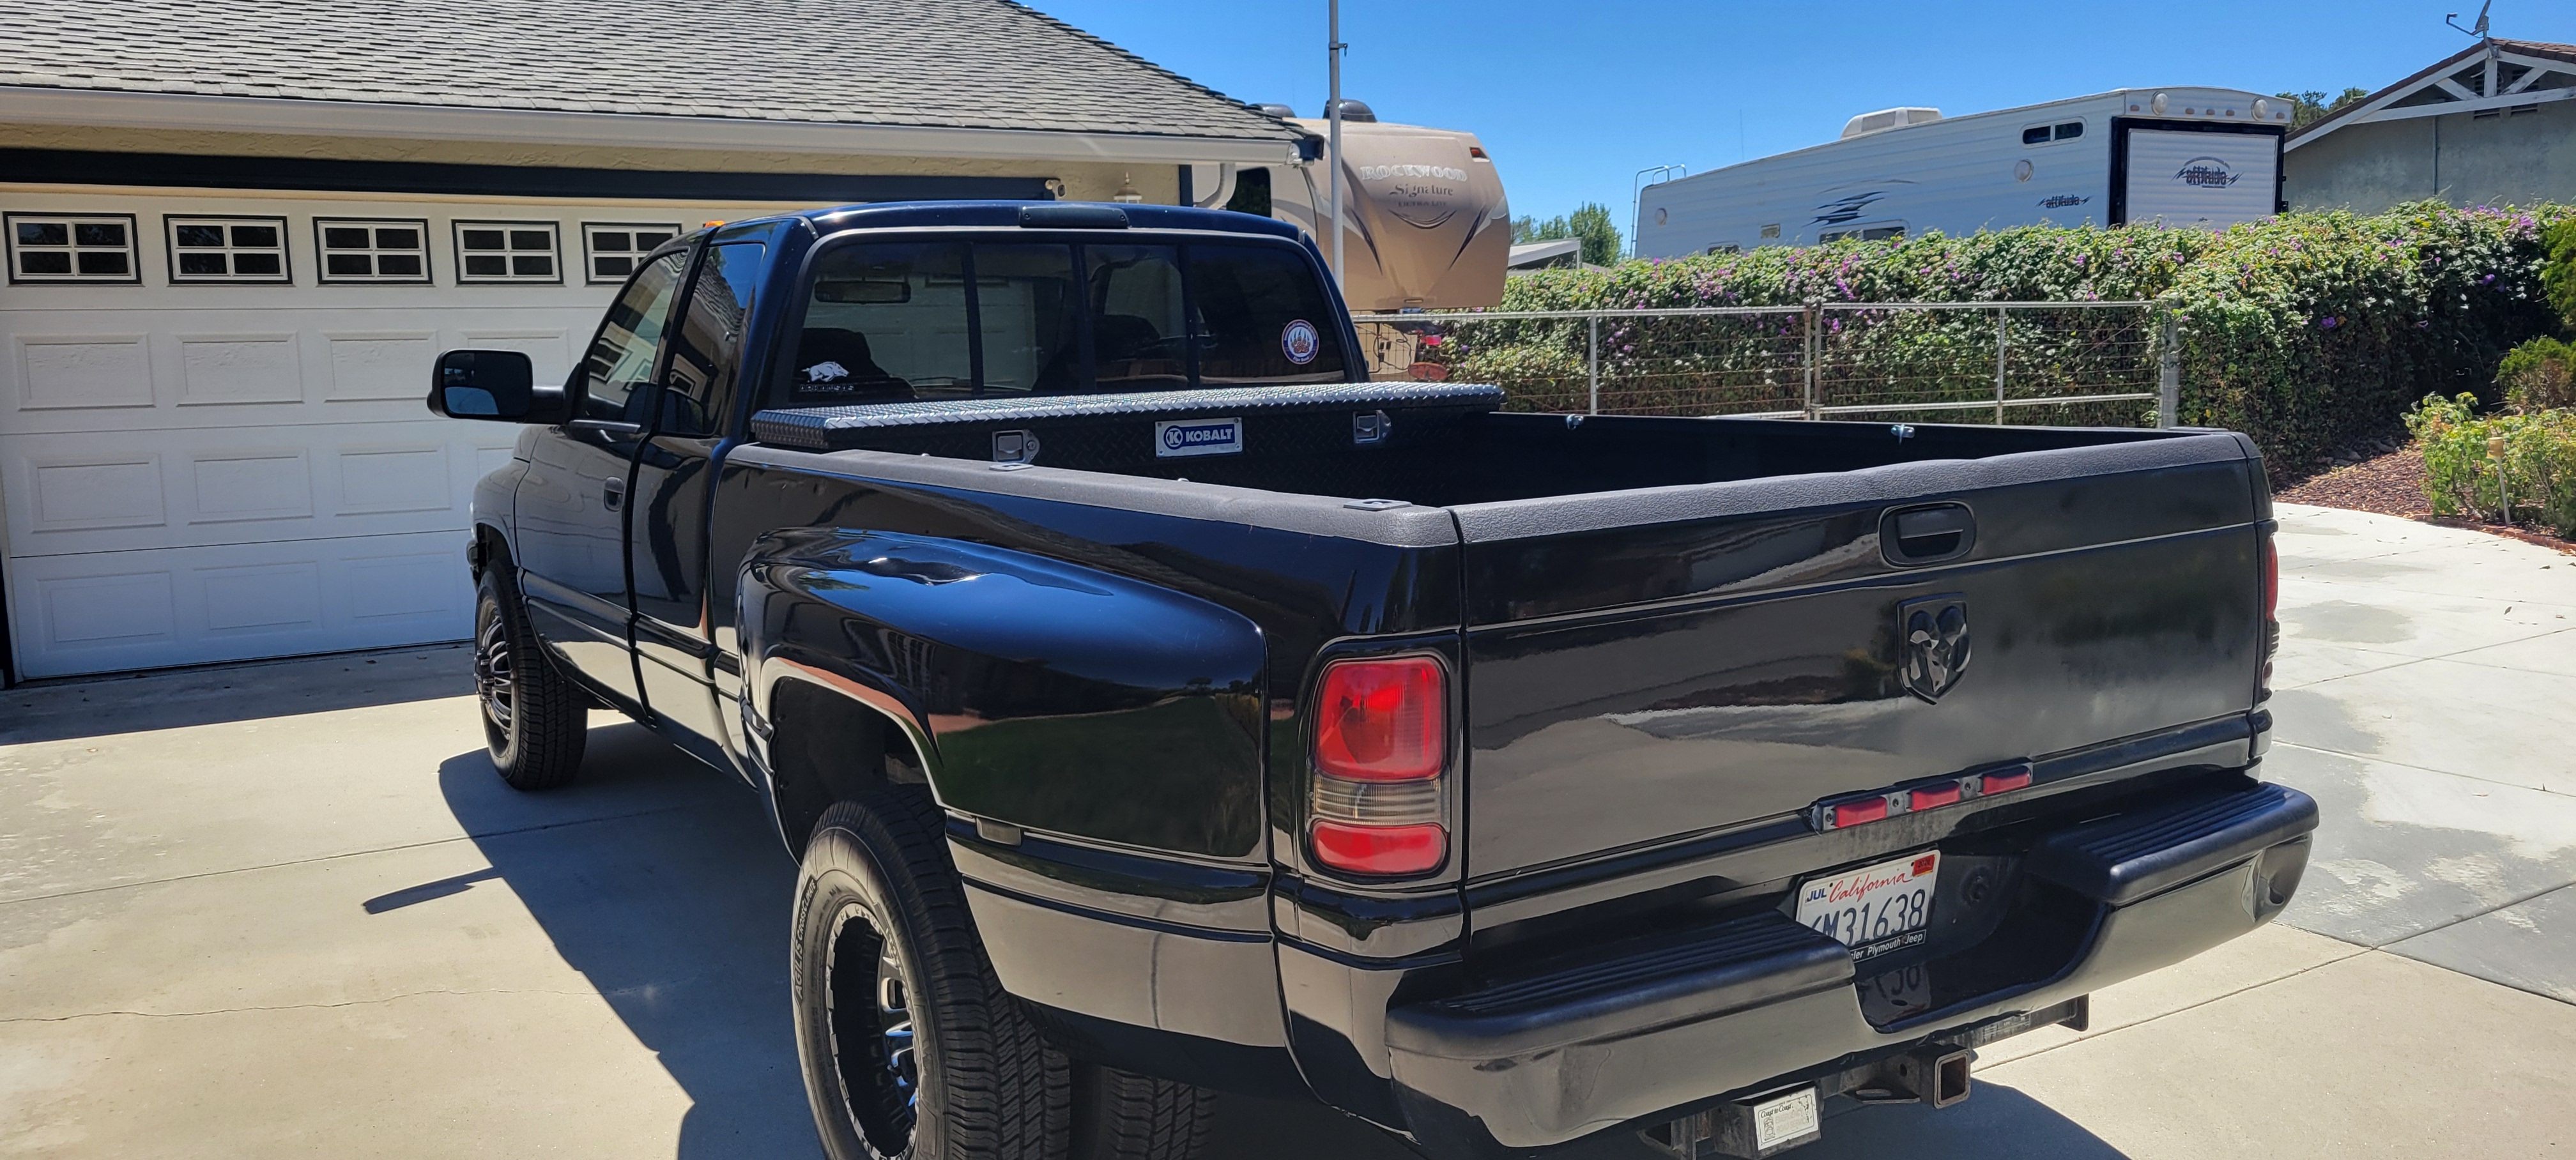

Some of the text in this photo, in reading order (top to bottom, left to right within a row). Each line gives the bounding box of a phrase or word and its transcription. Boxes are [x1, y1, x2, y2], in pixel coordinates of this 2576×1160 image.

[1359, 164, 1468, 182] ROCKWOOD
[1390, 183, 1454, 198] Signature
[1186, 429, 1232, 443] KOBALT
[1806, 869, 1912, 903] JUL California
[1867, 938, 1901, 956] Plymouth
[1905, 933, 1923, 944] Jeep
[795, 939, 803, 1000] AGILIS
[1761, 1110, 1774, 1118] Coast
